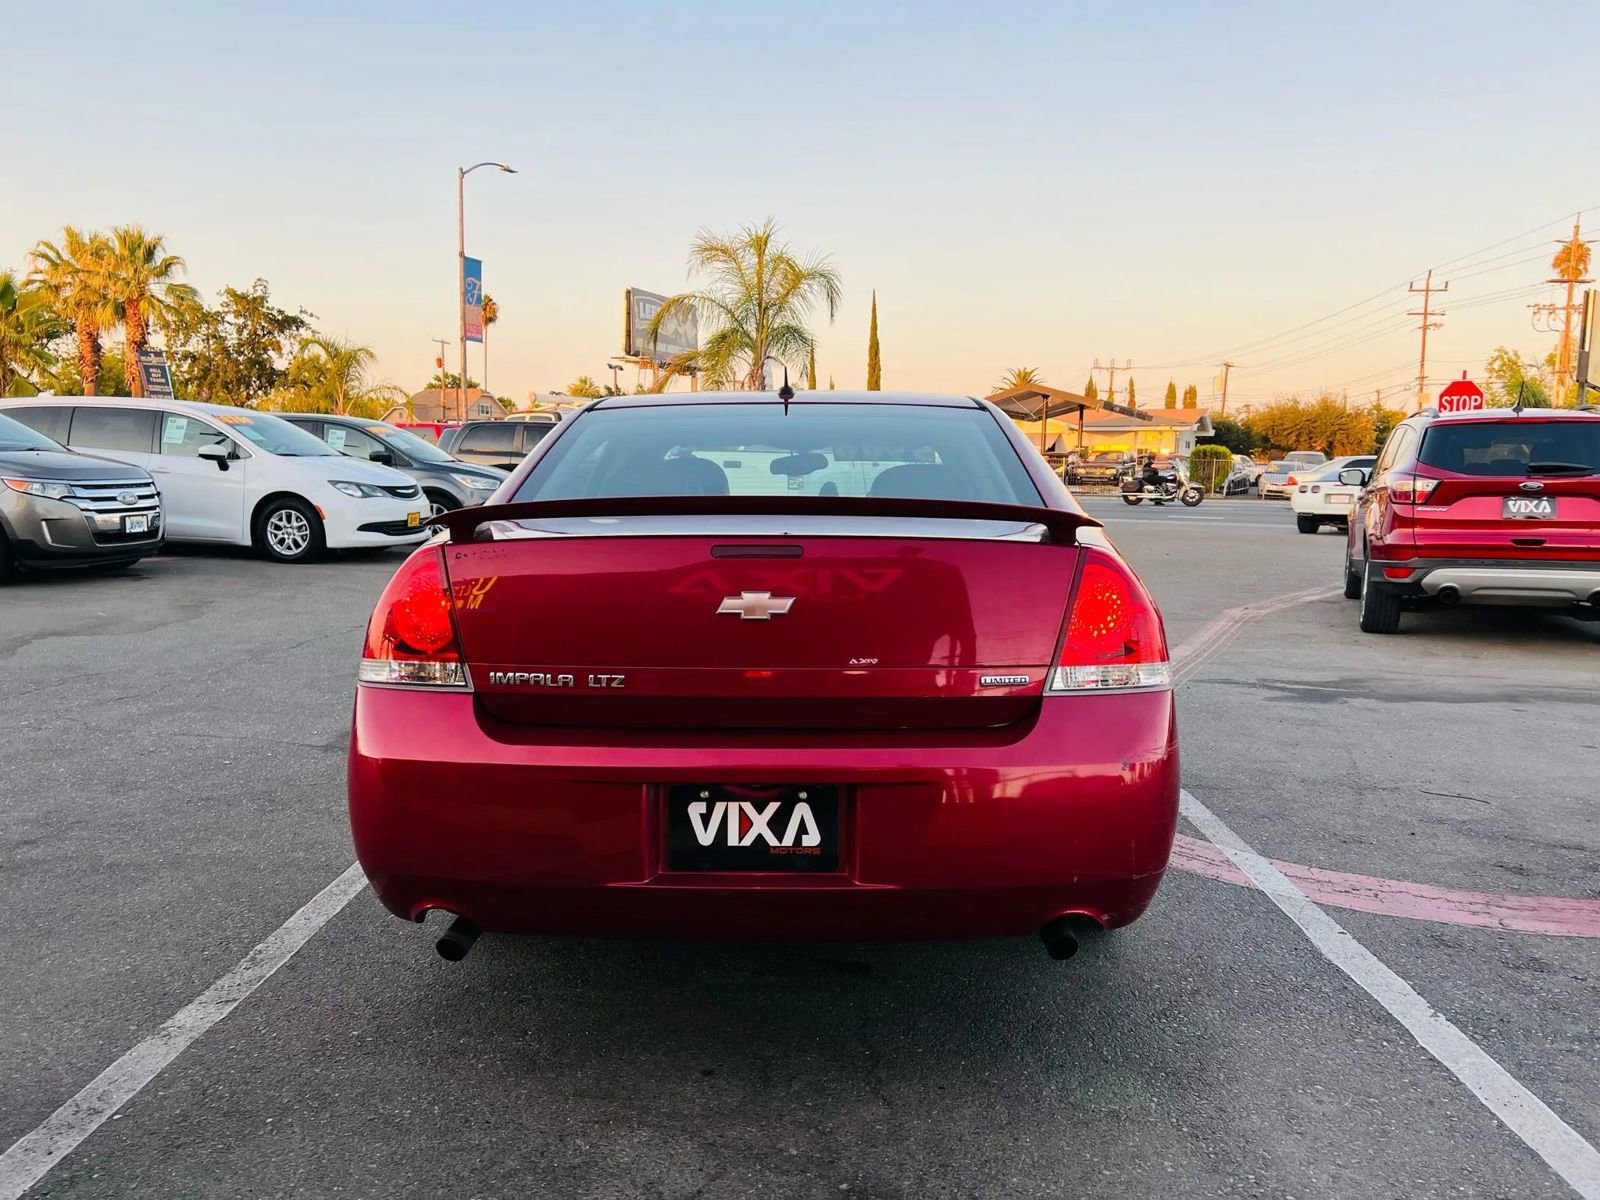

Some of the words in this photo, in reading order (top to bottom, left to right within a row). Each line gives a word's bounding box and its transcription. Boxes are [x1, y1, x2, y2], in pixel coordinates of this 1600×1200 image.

[1441, 395, 1482, 412] STOP
[1507, 500, 1551, 513] VIXA
[489, 672, 574, 687] IMPALA
[588, 674, 625, 688] LTZ
[983, 676, 1028, 685] LIMITED
[687, 801, 822, 847] VIXA
[769, 847, 822, 855] MOTORS
